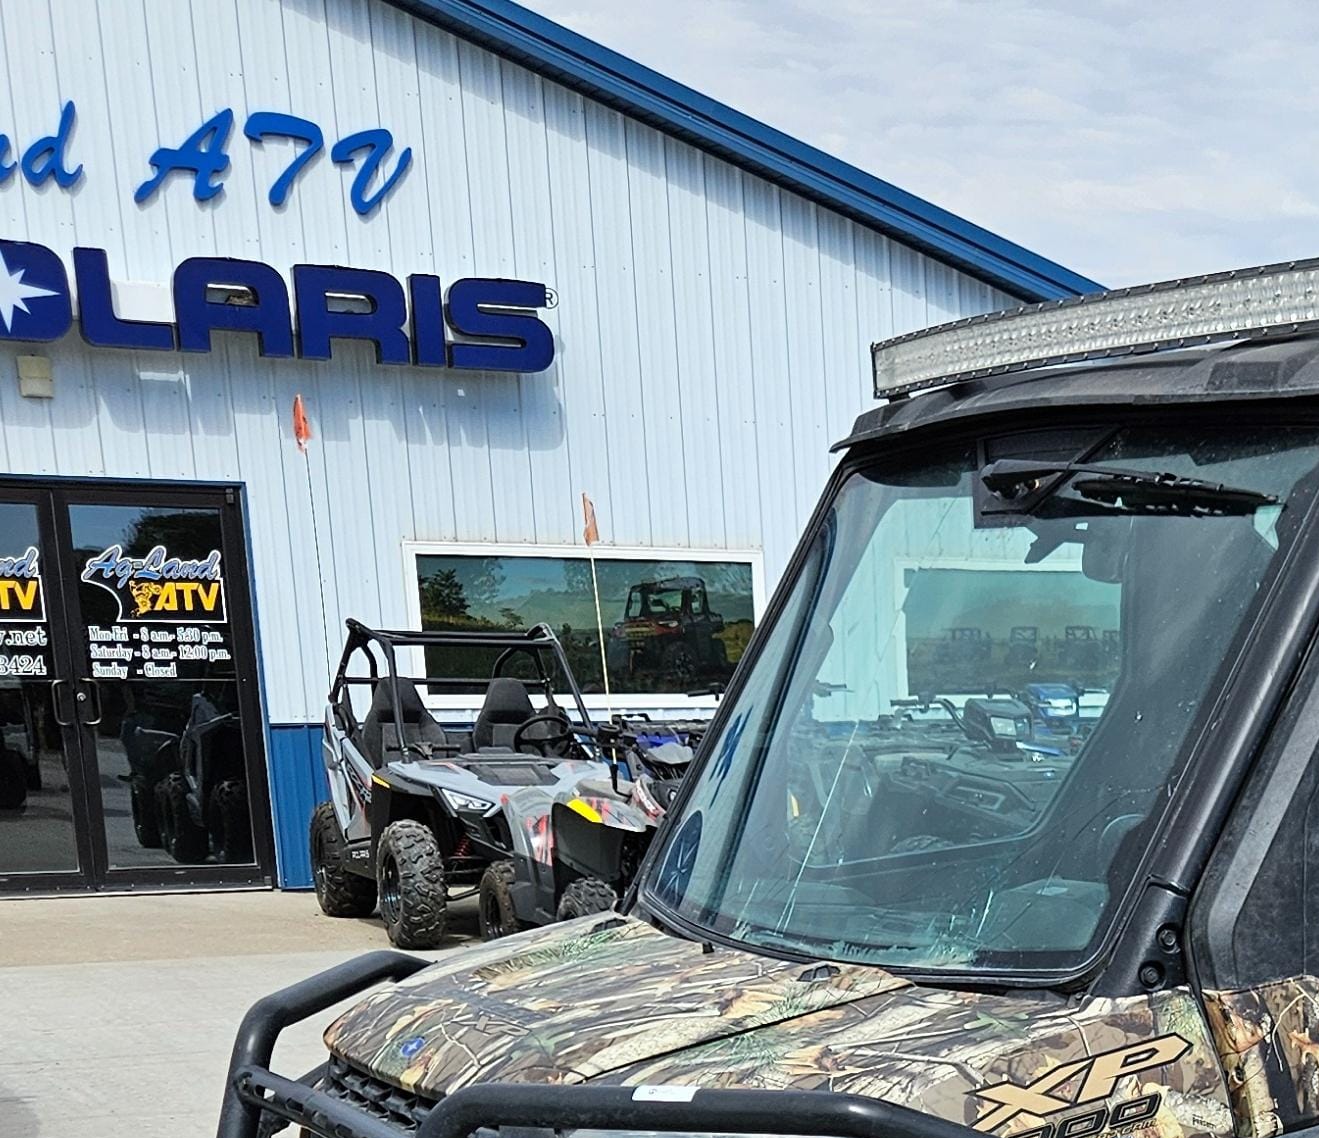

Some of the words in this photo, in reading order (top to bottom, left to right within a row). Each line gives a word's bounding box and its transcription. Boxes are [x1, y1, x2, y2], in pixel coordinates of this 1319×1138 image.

[134, 108, 412, 215] ATV
[82, 545, 221, 589] Ag-Land
[155, 581, 220, 612] ATV
[89, 643, 133, 661] Saturday
[92, 661, 128, 680] Sunday
[143, 662, 177, 678] Closed
[964, 1032, 1194, 1131] XP
